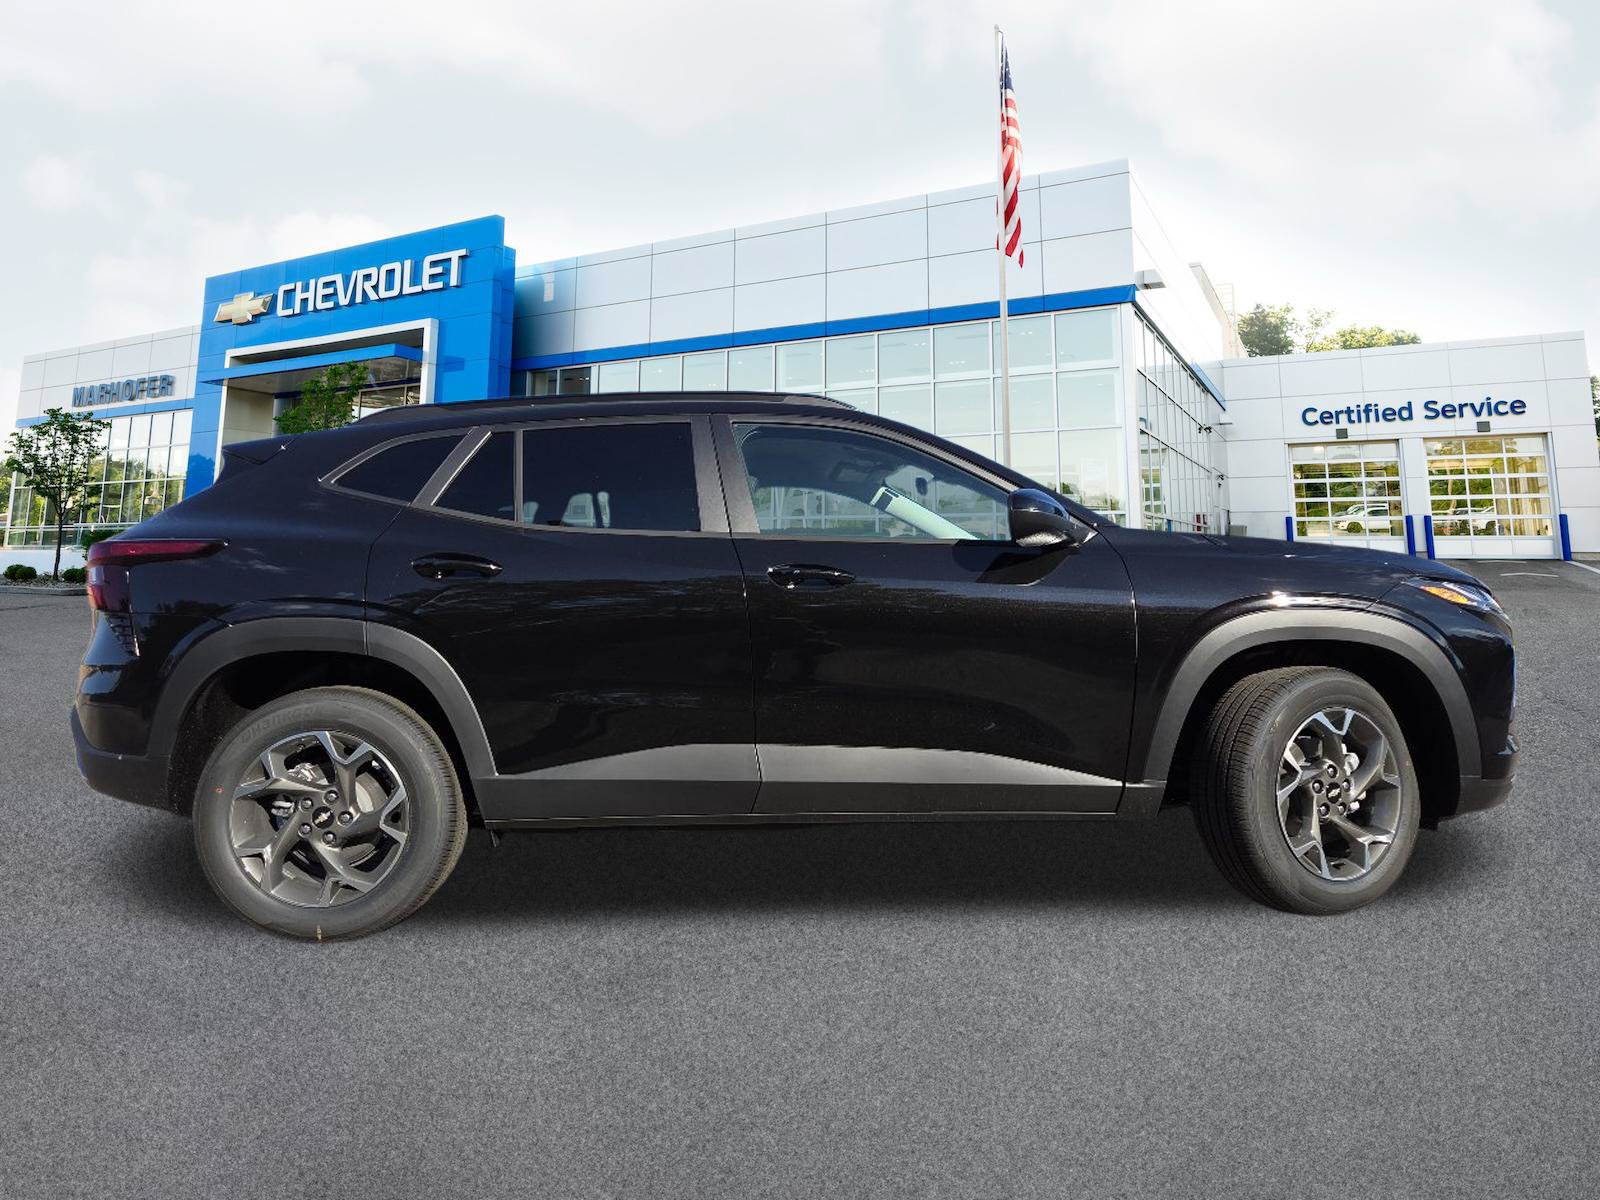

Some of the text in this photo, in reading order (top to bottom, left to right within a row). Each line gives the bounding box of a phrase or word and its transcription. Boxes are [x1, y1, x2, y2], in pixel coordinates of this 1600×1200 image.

[276, 248, 469, 317] CHEVROLET
[72, 374, 175, 407] MARHOFER
[1301, 396, 1527, 426] Certified Service
